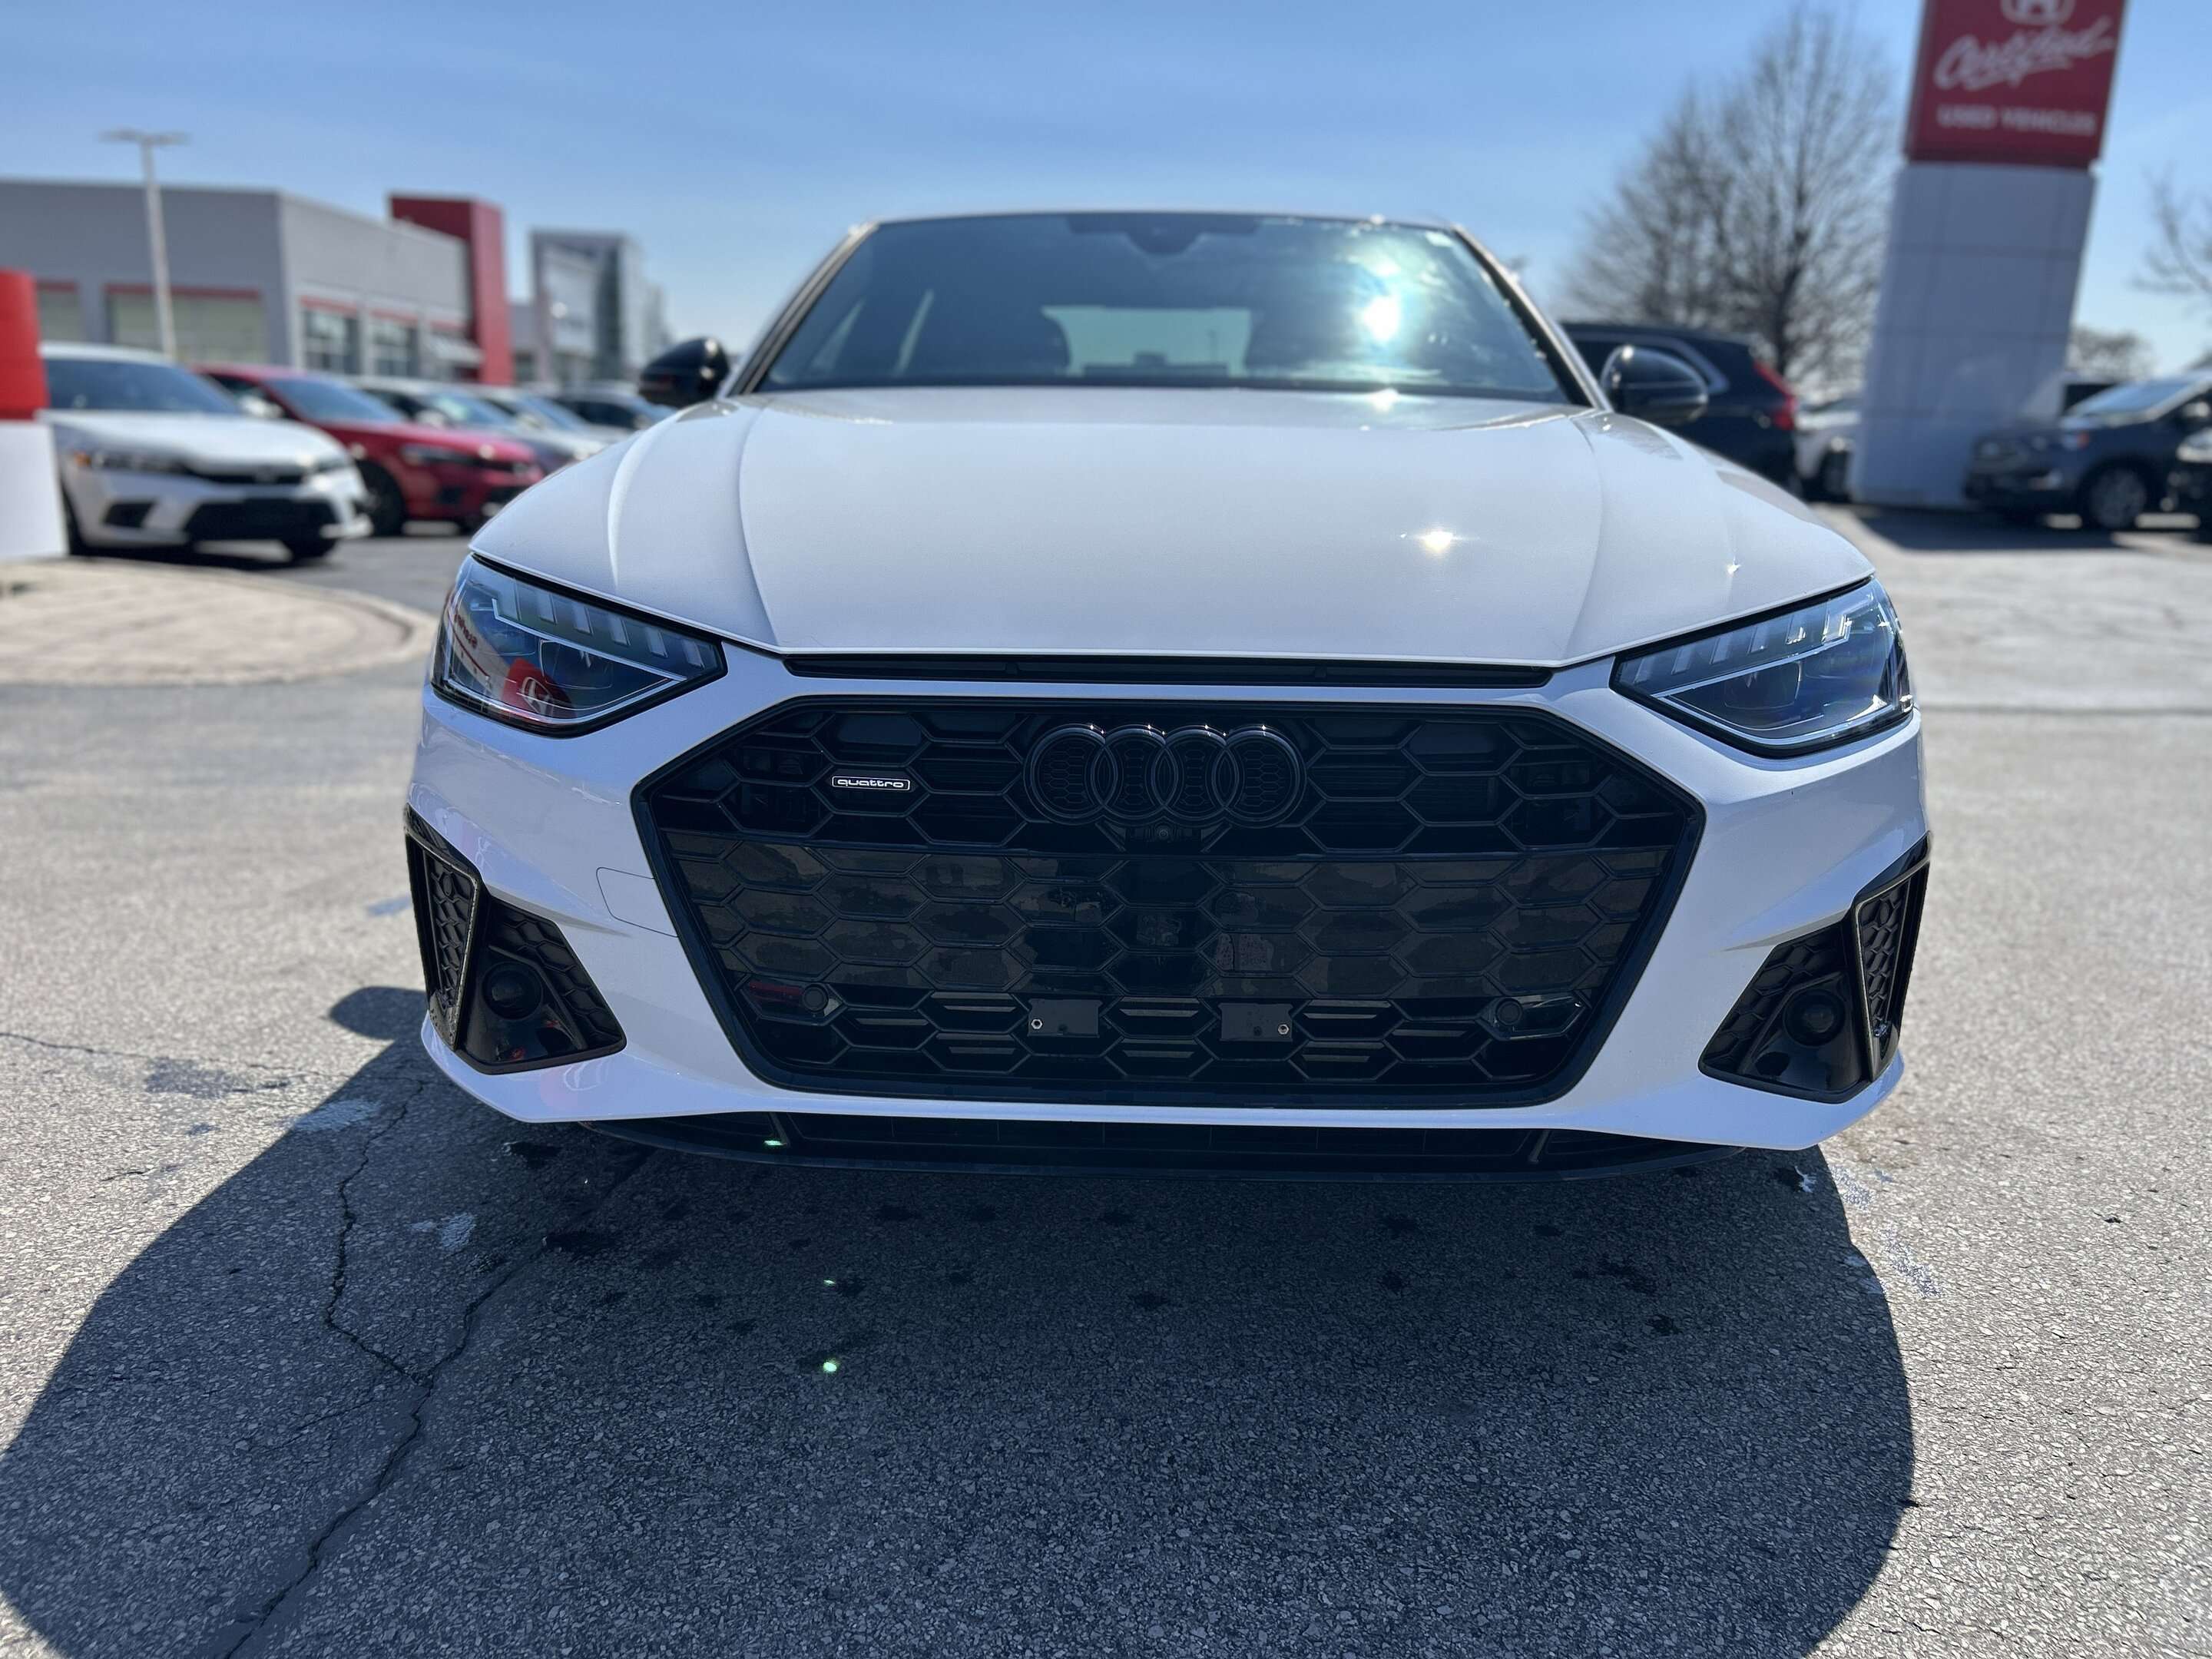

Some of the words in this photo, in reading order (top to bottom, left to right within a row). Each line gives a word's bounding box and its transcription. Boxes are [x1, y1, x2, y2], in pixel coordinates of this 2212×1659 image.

[1934, 15, 2114, 90] Certified
[1937, 104, 1996, 128] USED
[2001, 107, 2095, 135] VEHICLES
[837, 779, 904, 788] quattro
